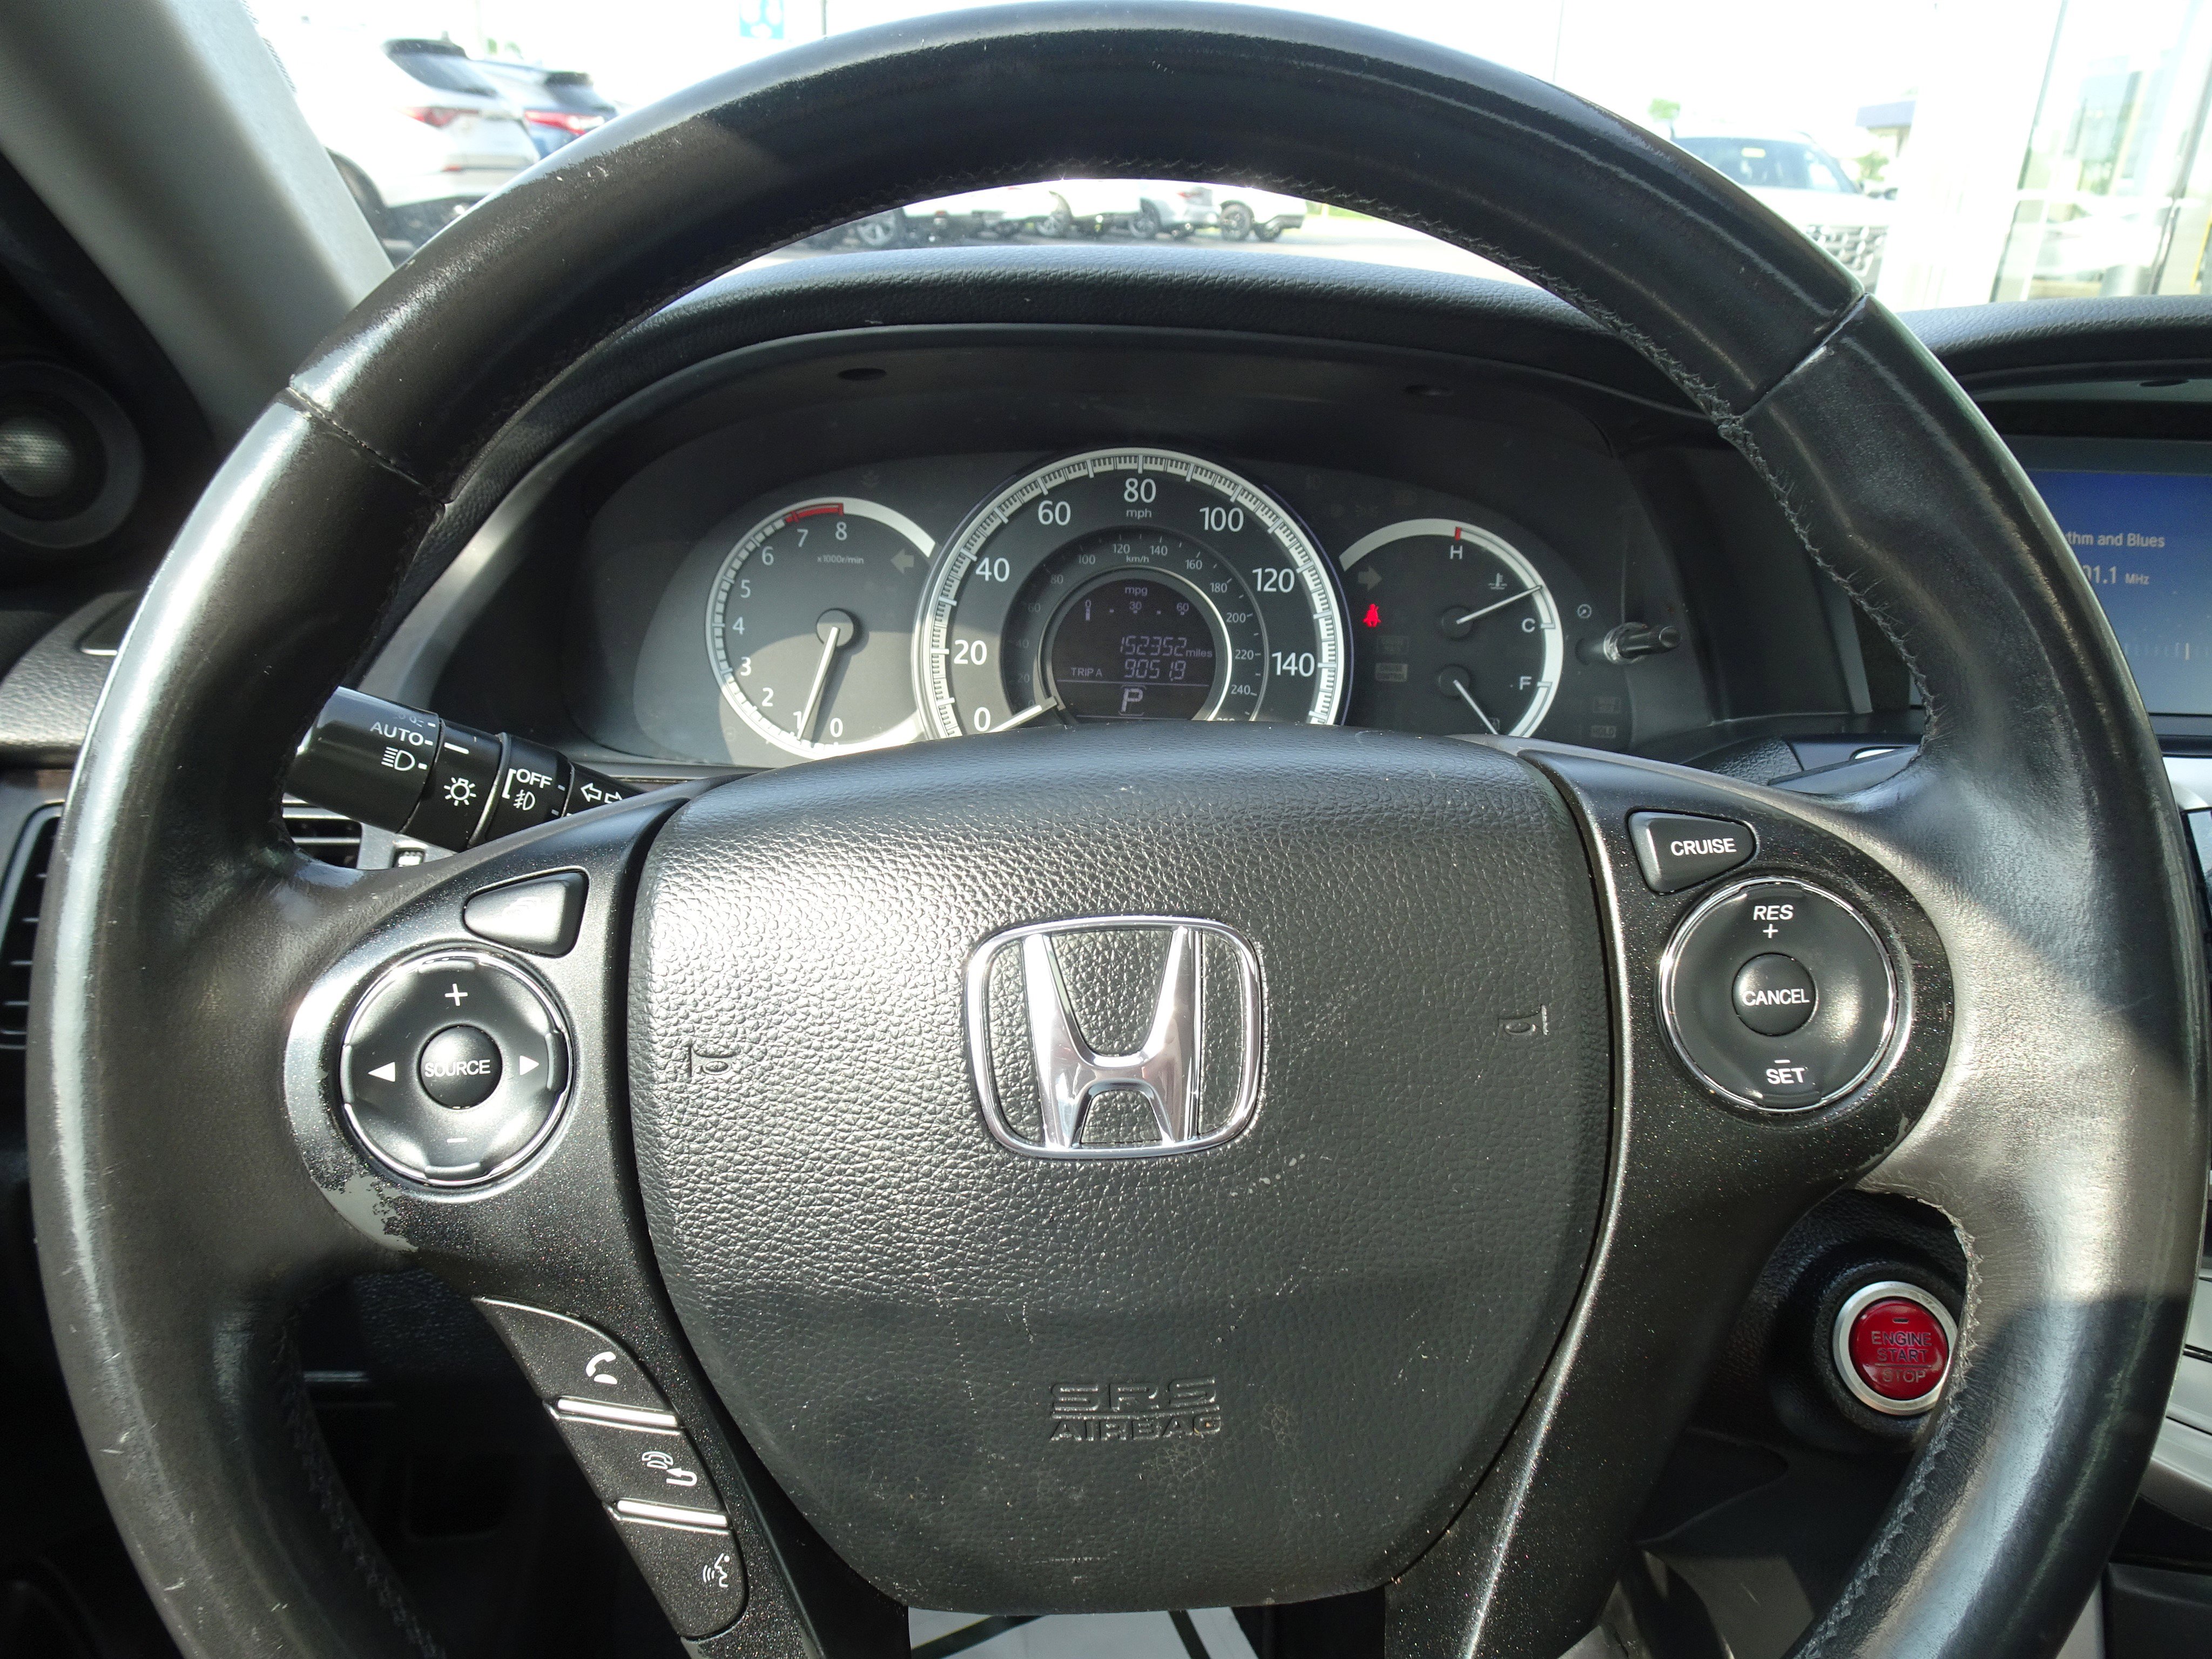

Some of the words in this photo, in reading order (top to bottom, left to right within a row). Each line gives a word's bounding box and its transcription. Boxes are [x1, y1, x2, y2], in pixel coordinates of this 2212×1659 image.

[1123, 478, 1157, 504] 80
[1038, 500, 1071, 526] 60
[1125, 508, 1152, 519] mph
[1199, 507, 1244, 532] 100
[797, 529, 809, 547] 7
[835, 521, 847, 540] 8
[2065, 531, 2094, 545] thm
[2097, 533, 2123, 547] and
[2126, 533, 2165, 548] Blues
[761, 545, 774, 565] 6
[1112, 543, 1130, 555] 120
[1150, 544, 1168, 556] 140
[1449, 544, 1463, 559] H
[1078, 554, 1096, 565] 100
[1126, 554, 1149, 564] km/h
[1185, 558, 1203, 570] 160
[976, 557, 1010, 582] 40
[2125, 572, 2149, 585] MHz
[740, 580, 751, 598] 5
[1210, 582, 1228, 594] 180
[1253, 568, 1294, 593] 120
[1125, 585, 1148, 596] mpg
[1176, 603, 1189, 612] 60
[732, 617, 745, 635] 4
[1226, 612, 1246, 623] 200
[1521, 618, 1536, 633] C
[954, 639, 987, 665] 20
[1120, 635, 1187, 657] 152352
[1185, 648, 1213, 658] miles
[1235, 649, 1253, 661] 220
[740, 657, 752, 676] 3
[1070, 667, 1094, 677] TRIP
[1095, 667, 1103, 677] A
[1272, 652, 1314, 677] 140
[1231, 684, 1251, 695] 240
[1519, 676, 1533, 690] F
[762, 688, 774, 706] 2
[1121, 688, 1143, 712] P
[830, 718, 844, 737] 0
[974, 707, 991, 732] 0
[369, 721, 424, 746] AUTO
[516, 768, 552, 788] OFF
[1670, 838, 1737, 857] CRUISE
[1753, 905, 1794, 921] RES
[1742, 988, 1810, 1006] CANCEL
[424, 1059, 491, 1077] SOURCE
[1766, 1068, 1805, 1084] SET
[1871, 1331, 1932, 1346] ENGINE
[1876, 1348, 1927, 1363] START
[1883, 1369, 1926, 1383] STOP
[1051, 1376, 1216, 1413] SRS
[1050, 1415, 1222, 1442] AIRBAG
